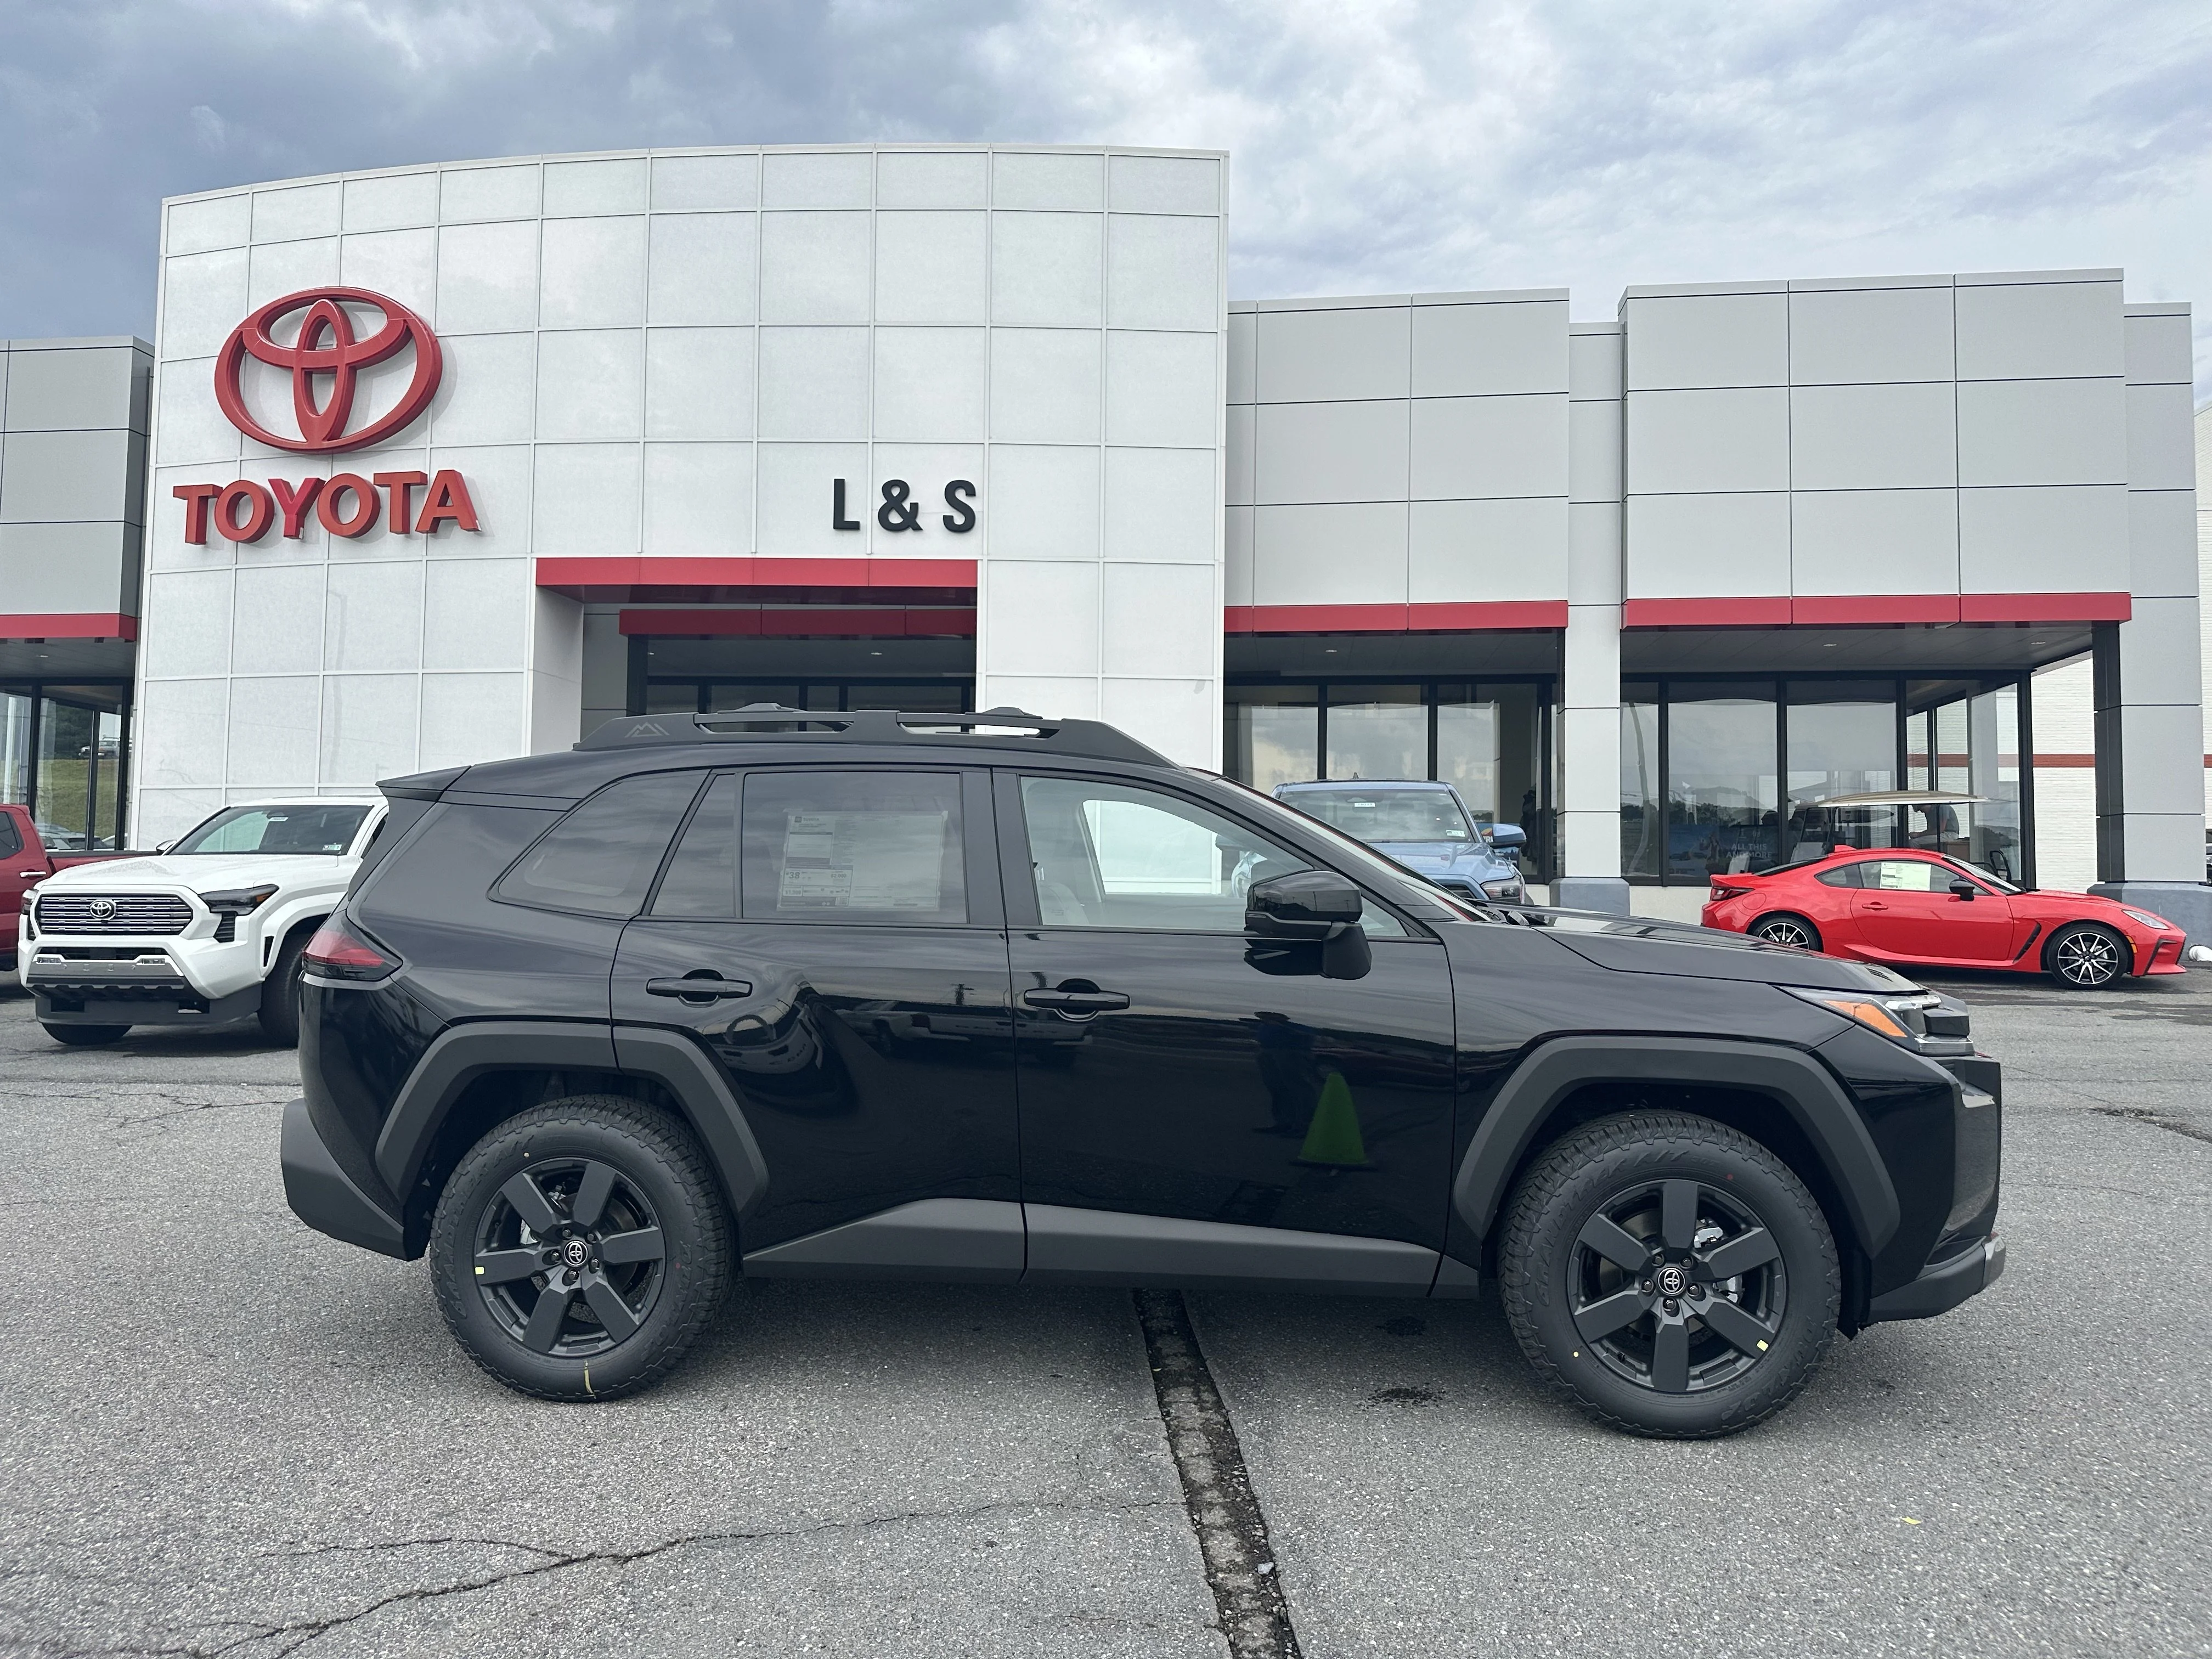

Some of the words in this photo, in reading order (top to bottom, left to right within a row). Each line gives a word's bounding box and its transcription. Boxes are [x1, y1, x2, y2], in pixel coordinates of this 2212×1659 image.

[173, 470, 481, 545] TOYOTA
[833, 478, 860, 530] L
[878, 479, 923, 532] &
[943, 479, 976, 533] S
